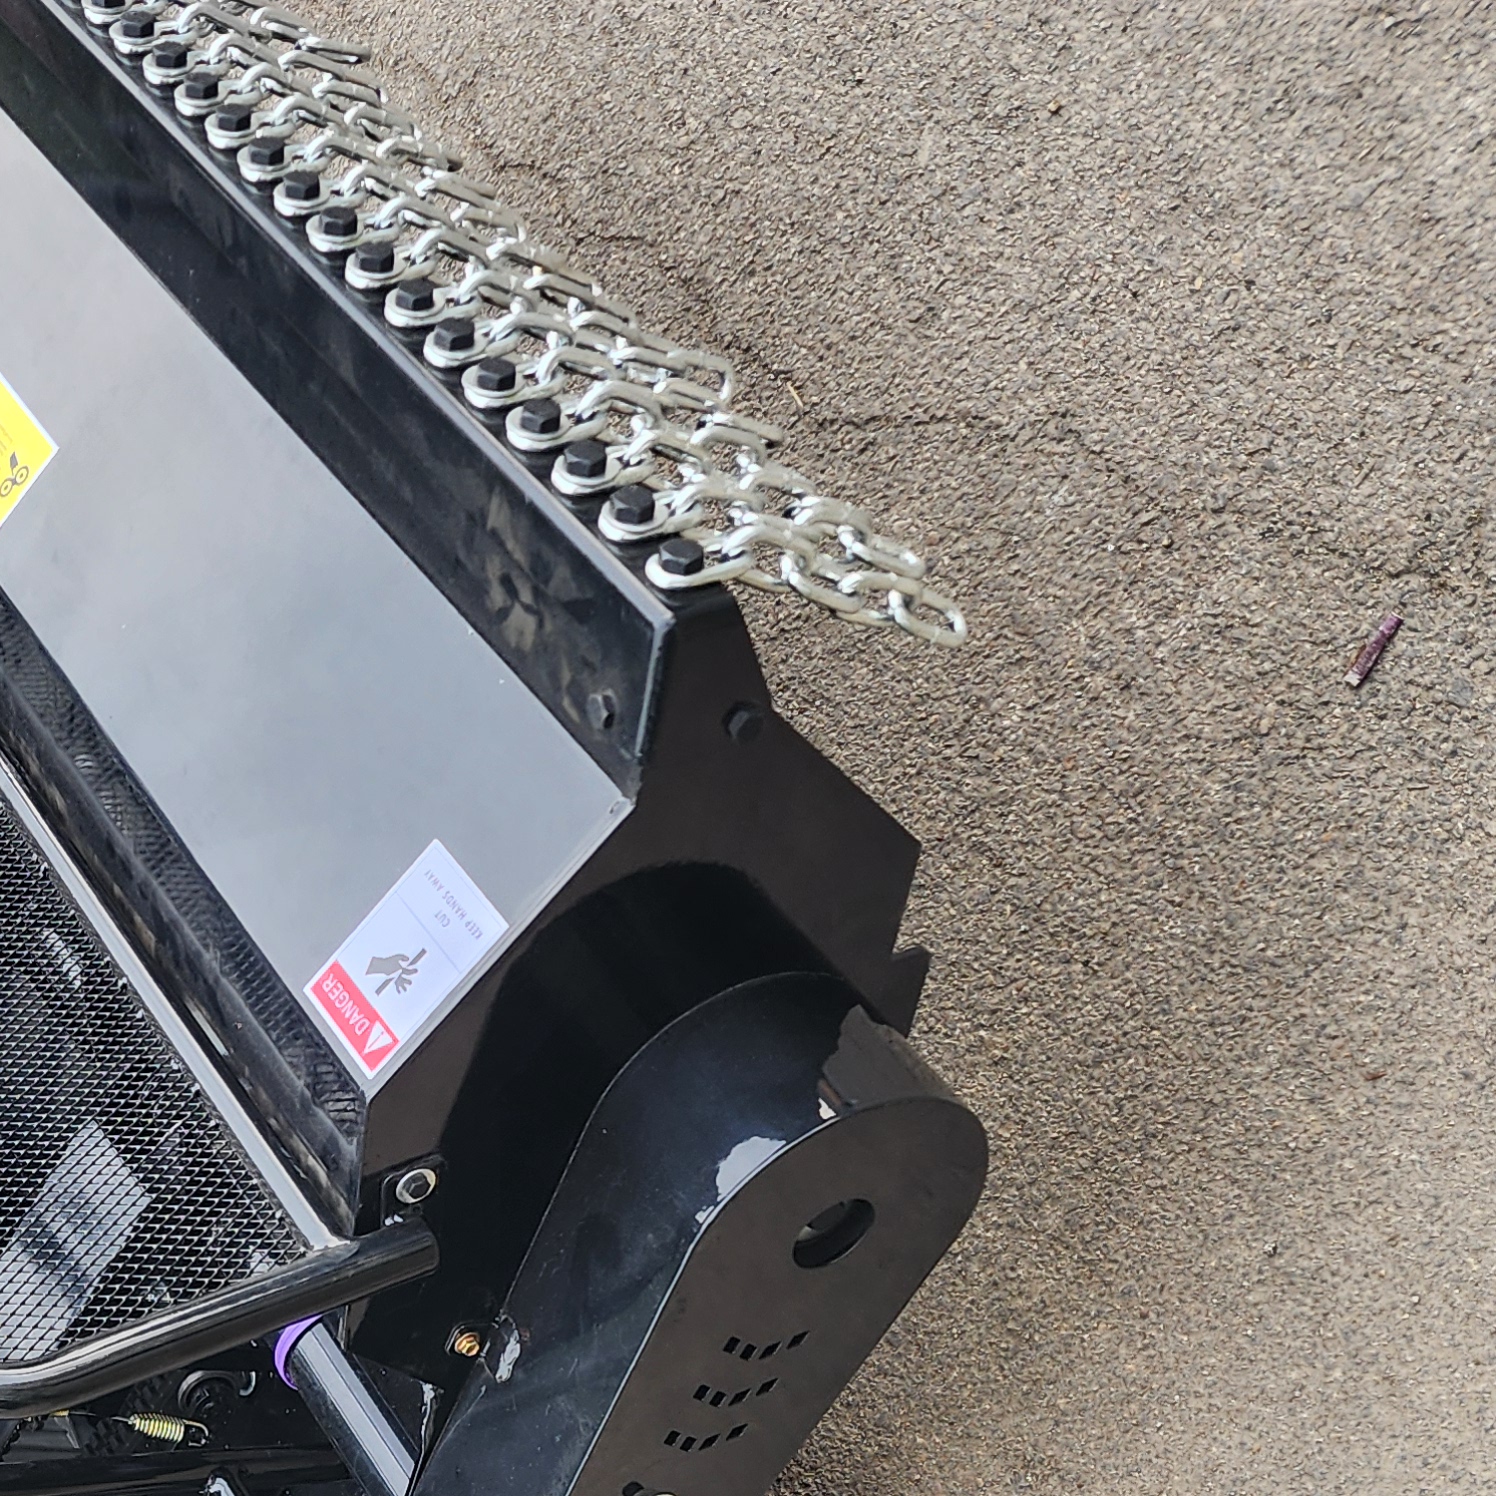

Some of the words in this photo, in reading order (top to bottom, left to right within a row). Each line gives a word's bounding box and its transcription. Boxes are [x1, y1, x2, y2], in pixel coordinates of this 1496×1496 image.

[424, 868, 447, 892] AWAY
[442, 890, 467, 919] HANDS
[433, 909, 451, 928] CUT
[462, 919, 483, 940] KEEP
[321, 973, 371, 1036] DANGER
